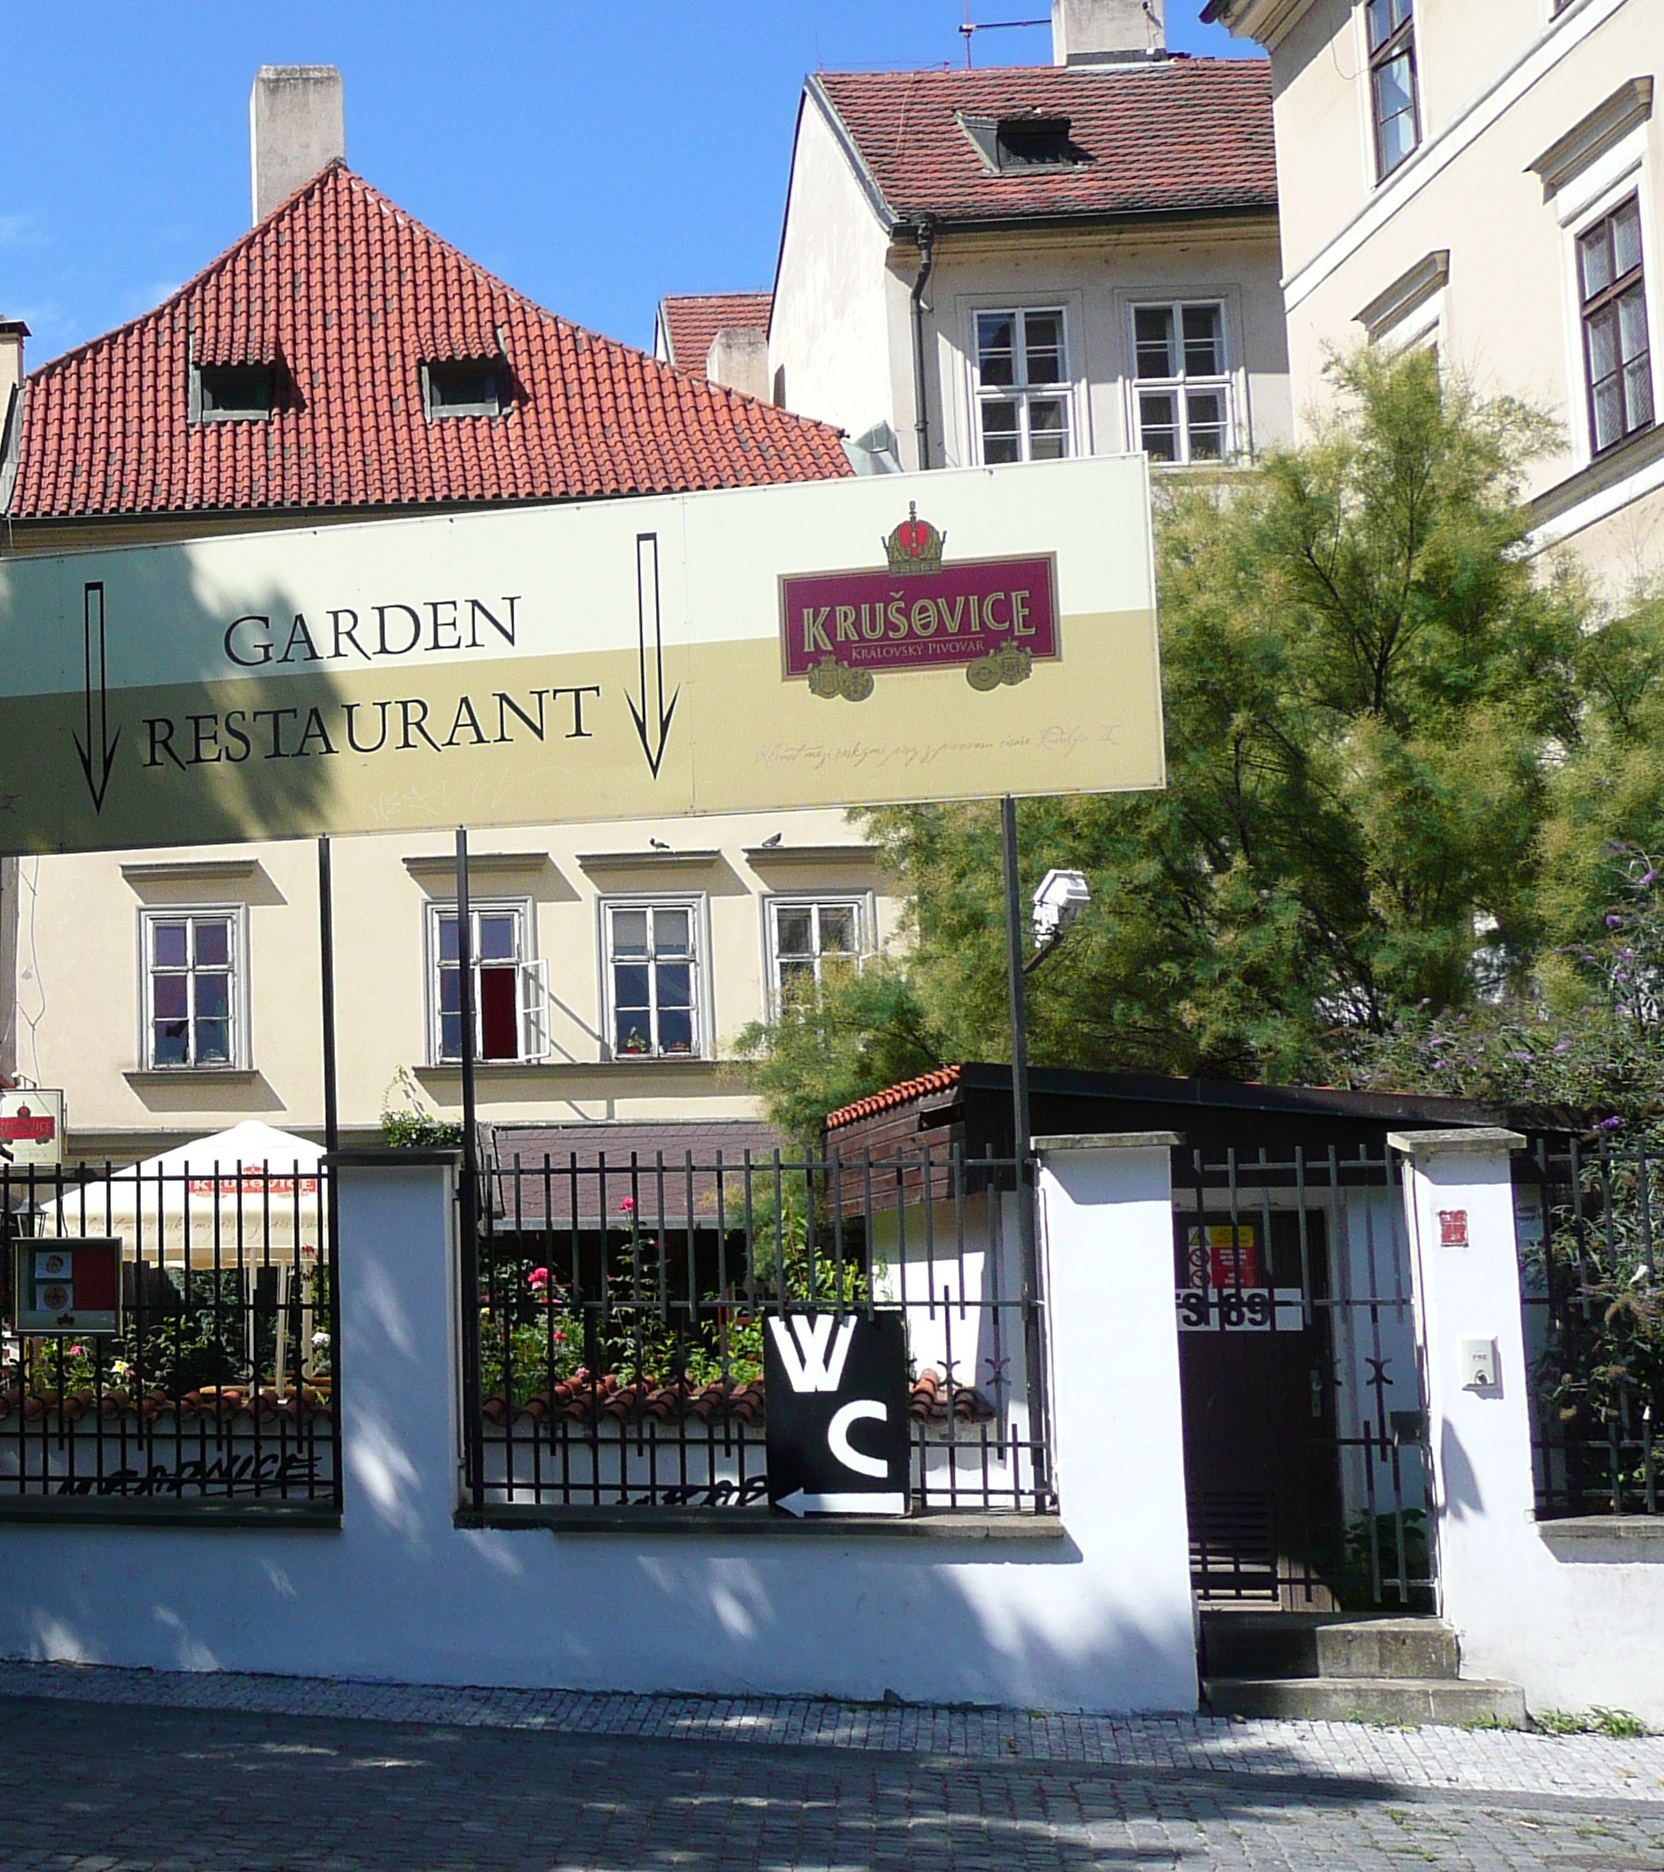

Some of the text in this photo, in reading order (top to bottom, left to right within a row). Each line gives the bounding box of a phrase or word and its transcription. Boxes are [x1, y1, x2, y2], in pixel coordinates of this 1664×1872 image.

[224, 595, 521, 667] GARDEN
[802, 590, 1036, 652] KRUŠOVICE
[928, 640, 985, 655] PIVOVAR
[142, 685, 600, 772] RESTAURANT
